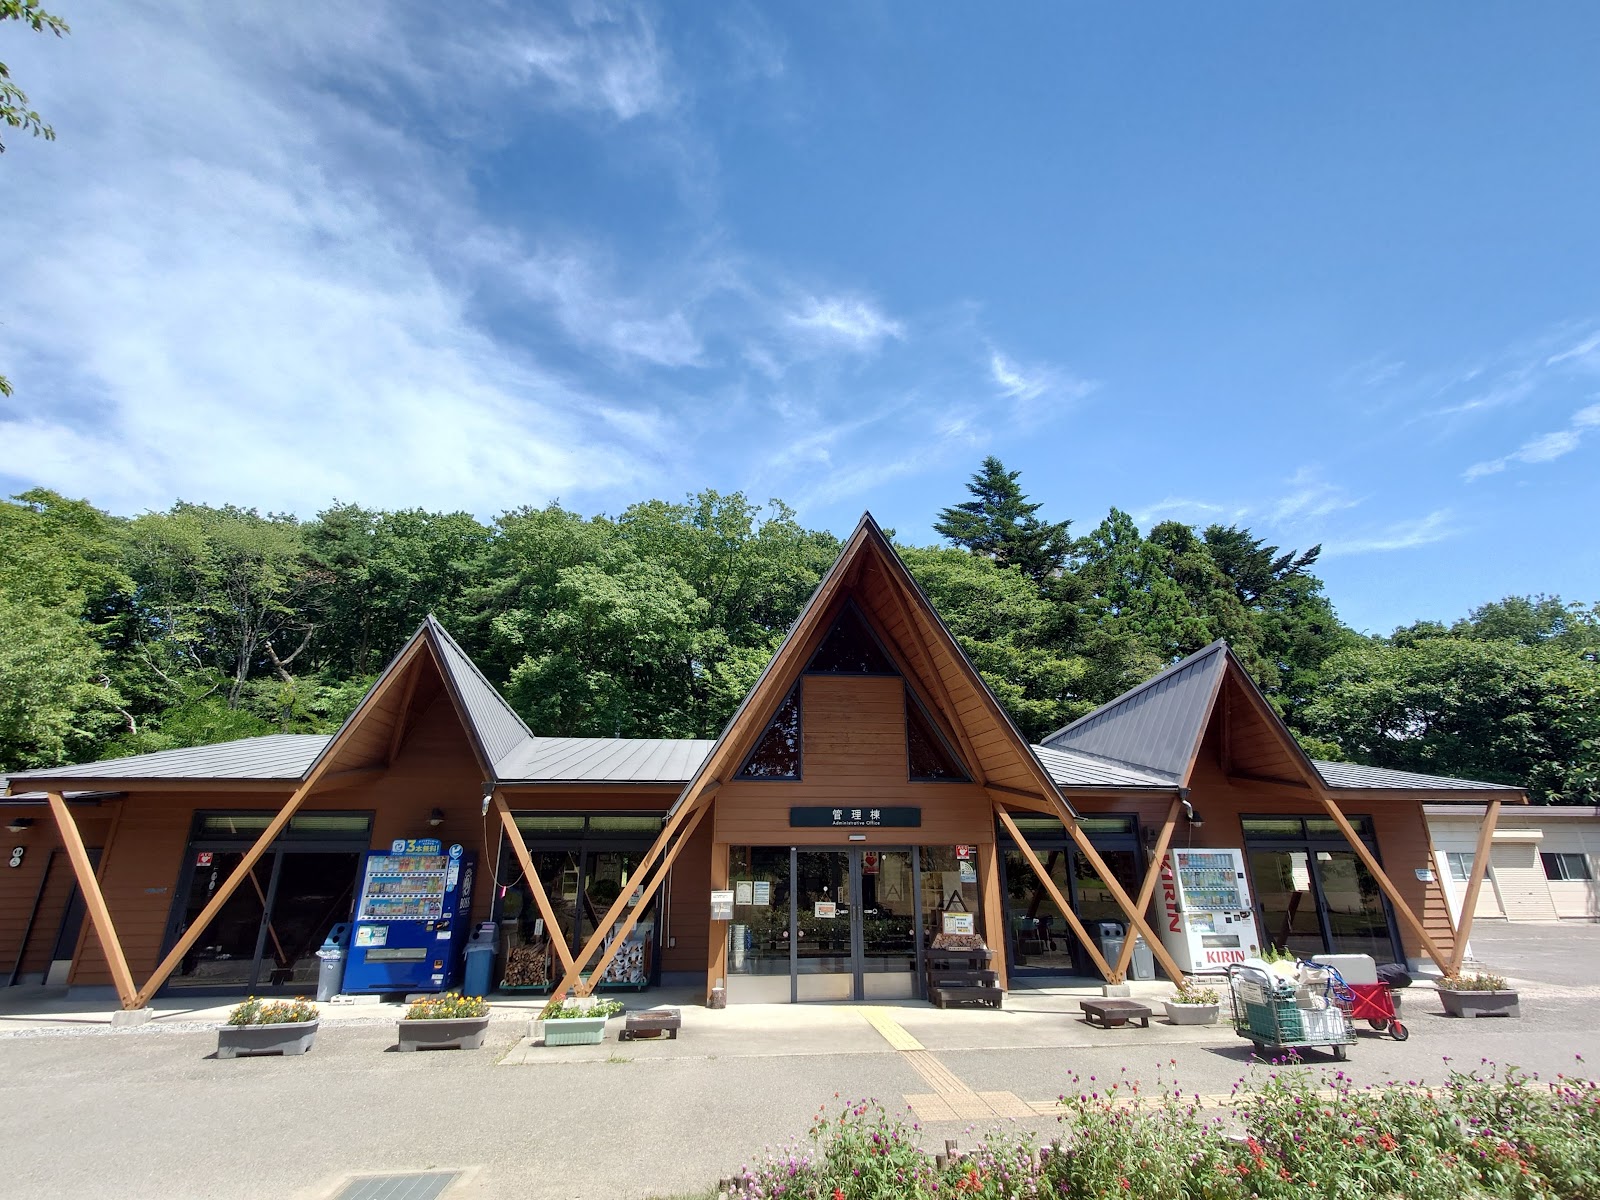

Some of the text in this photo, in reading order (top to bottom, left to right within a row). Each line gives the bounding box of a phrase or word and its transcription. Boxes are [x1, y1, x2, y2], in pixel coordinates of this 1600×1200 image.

[832, 809, 881, 820] 管理棟
[1161, 854, 1182, 933] KIRIN
[1206, 950, 1245, 963] KIRIN
